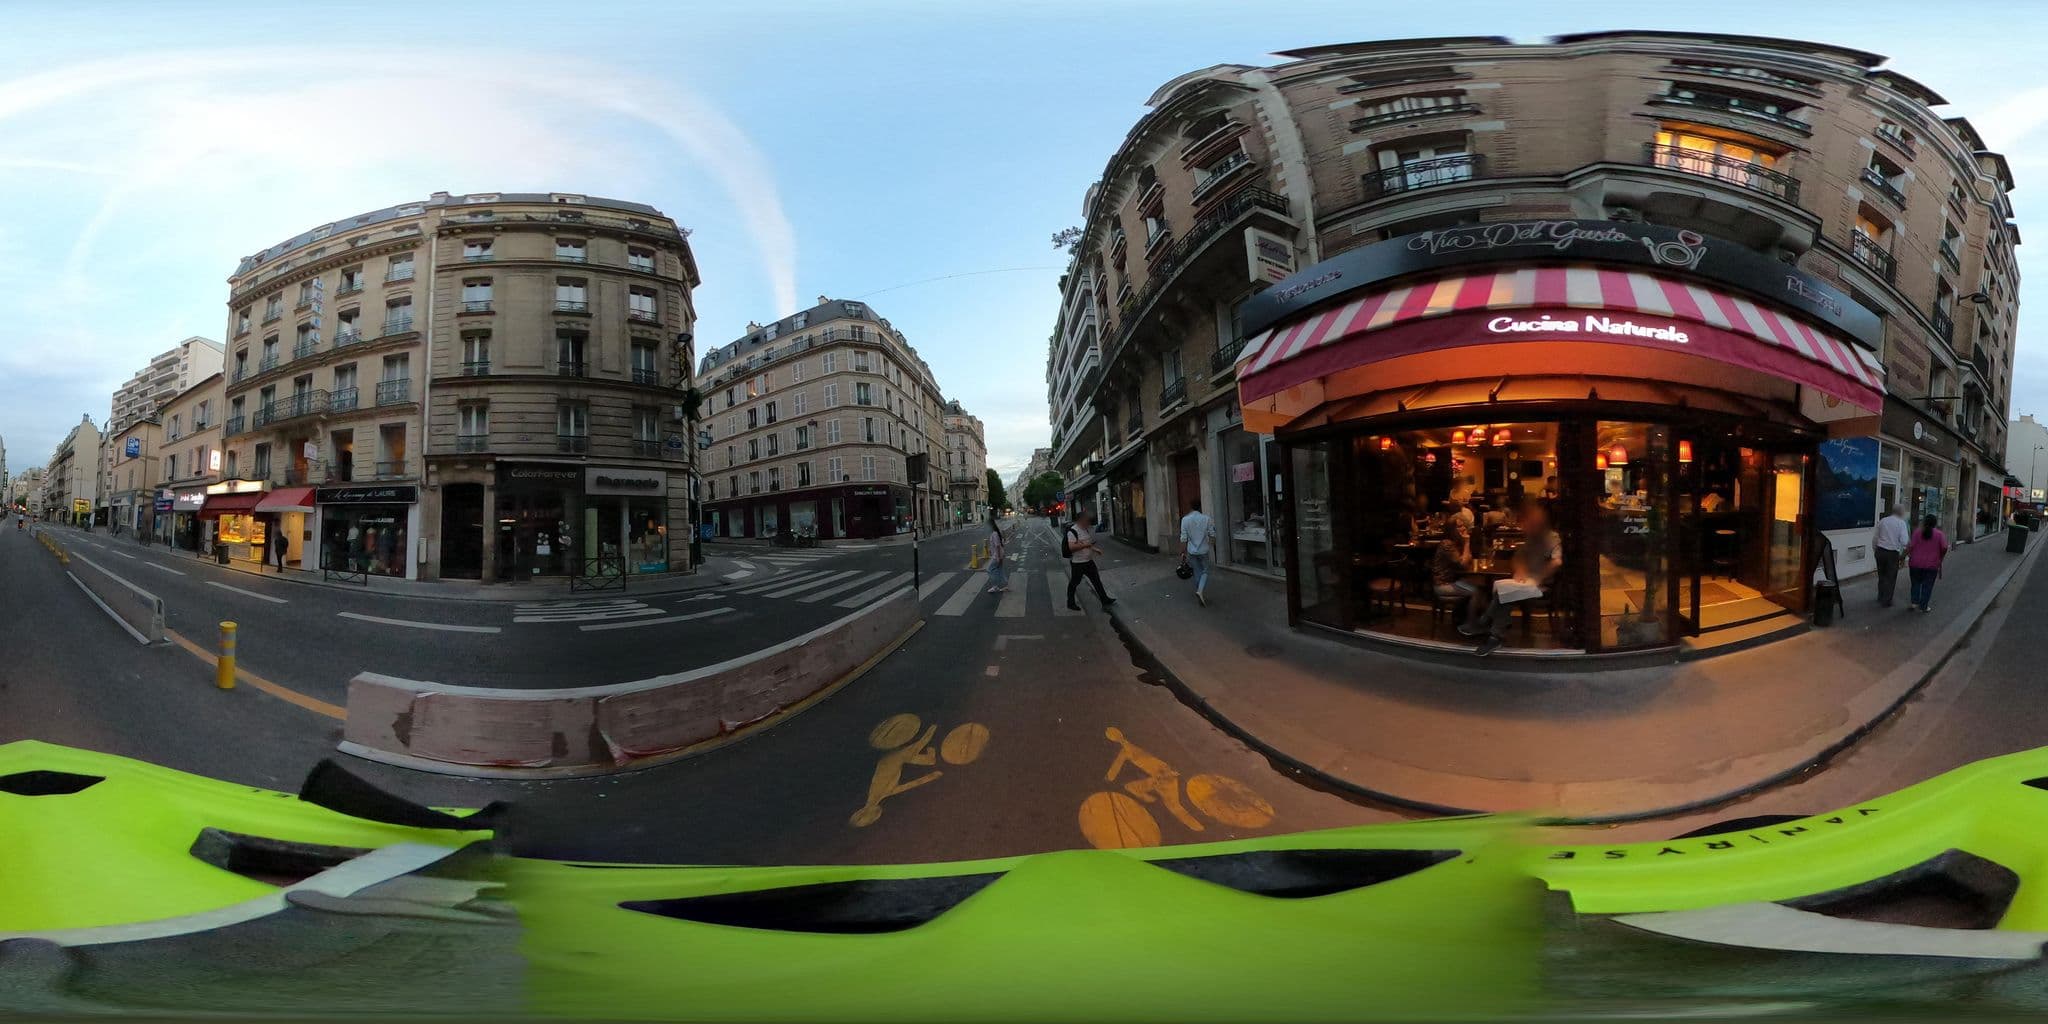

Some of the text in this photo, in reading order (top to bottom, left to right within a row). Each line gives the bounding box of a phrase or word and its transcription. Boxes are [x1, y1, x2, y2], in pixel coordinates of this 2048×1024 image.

[1407, 220, 1632, 255] Via Del Gusto
[1488, 314, 1690, 344] Cucina Naturale
